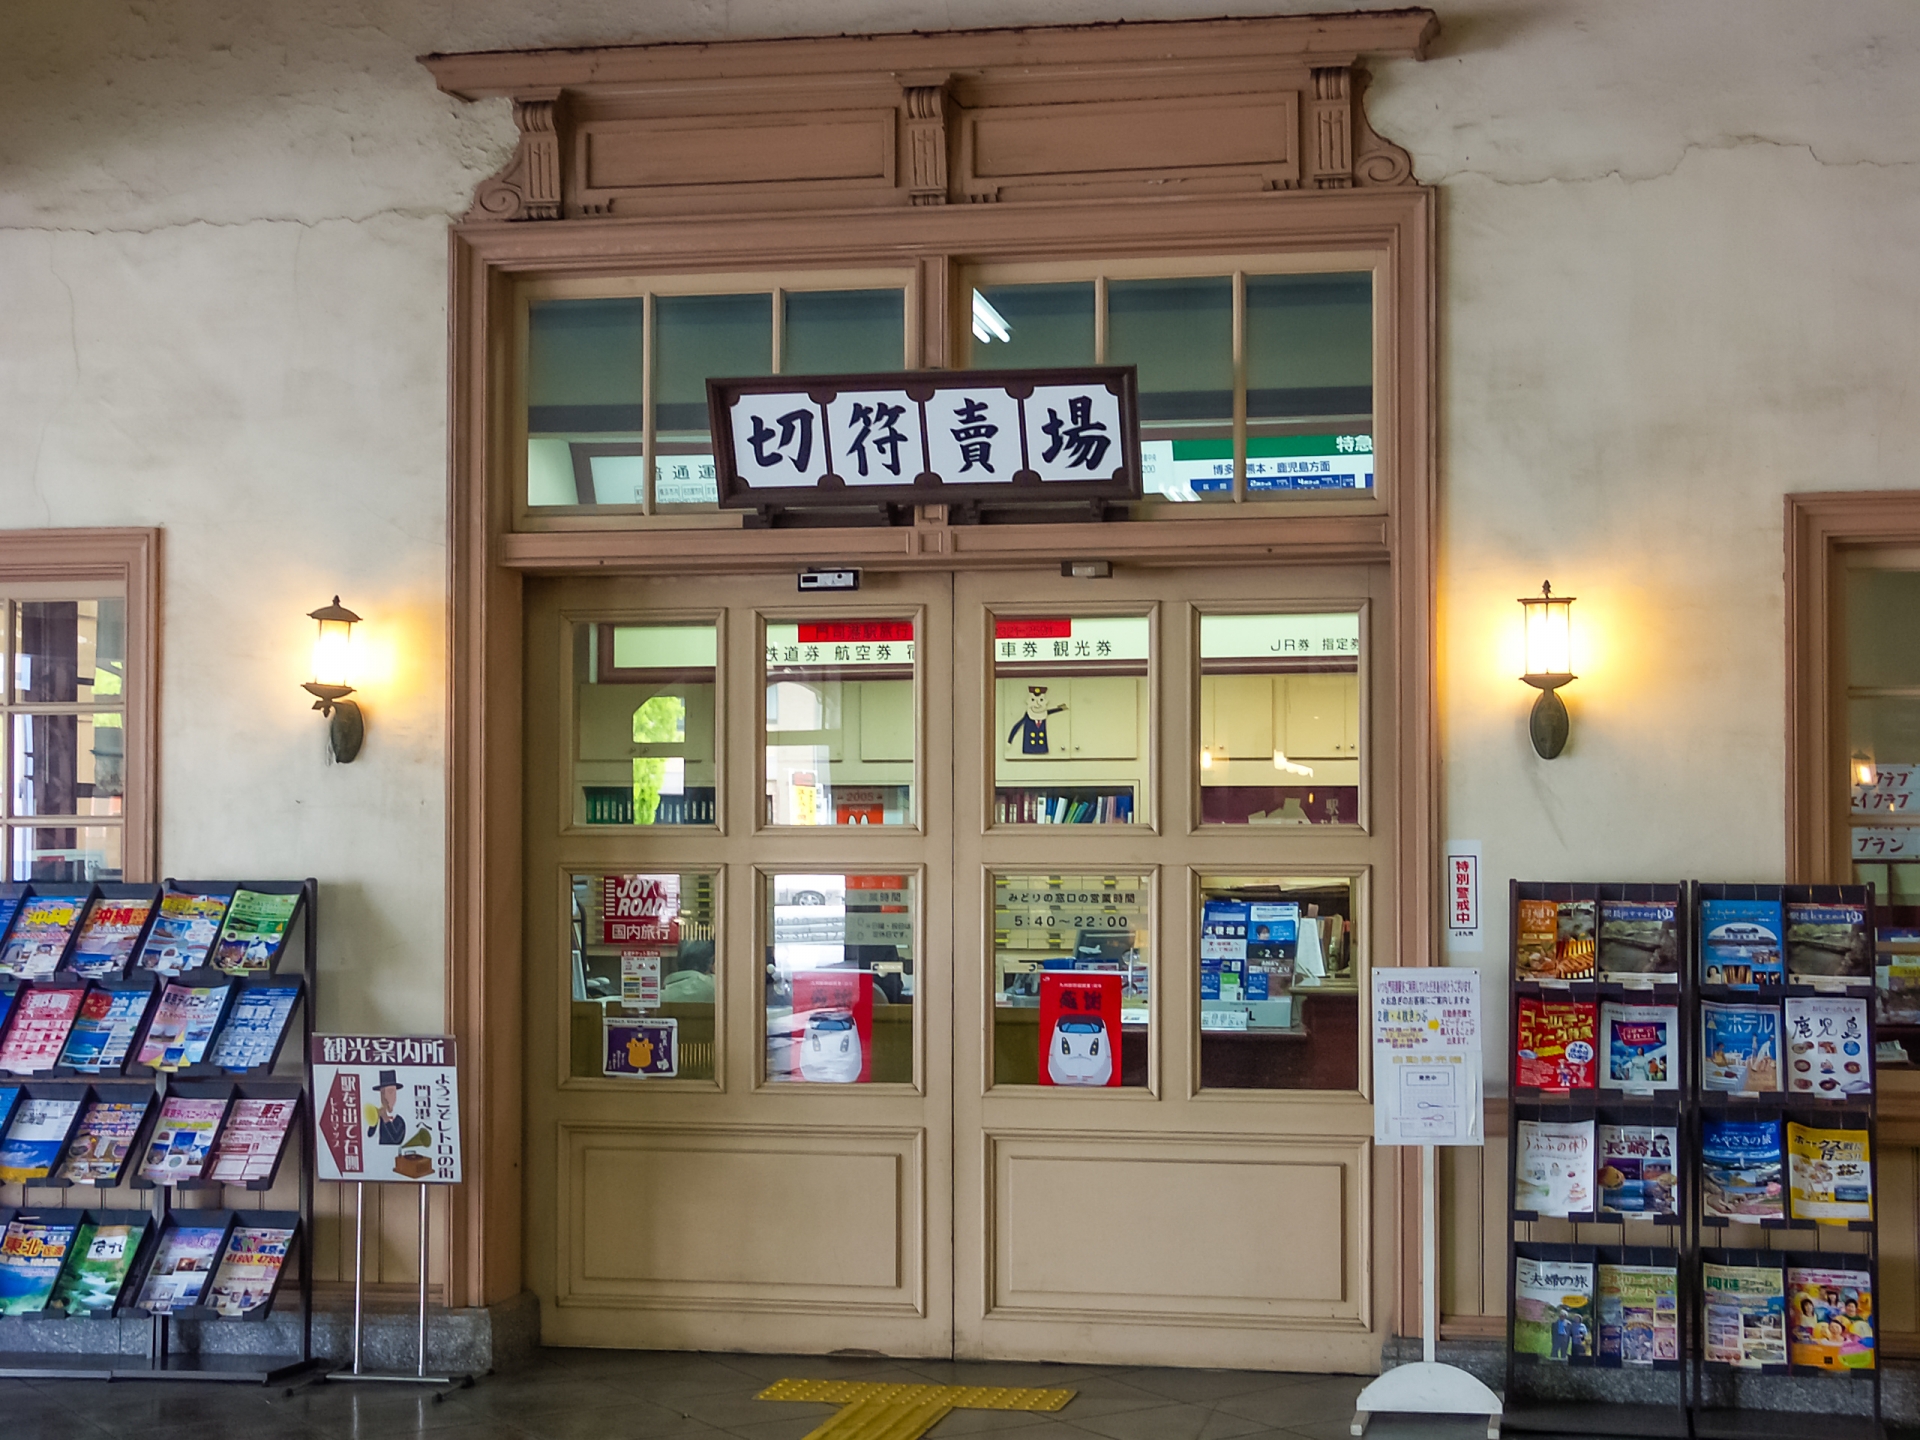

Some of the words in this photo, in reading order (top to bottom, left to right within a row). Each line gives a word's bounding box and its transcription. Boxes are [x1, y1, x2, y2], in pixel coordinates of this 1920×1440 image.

[747, 396, 1112, 477] 切符賣場
[834, 644, 892, 661] 航空券
[1053, 640, 1112, 657] 観光券
[616, 880, 655, 898] JOY
[1008, 892, 1135, 904] みどりの窓口の営業時間
[1455, 860, 1471, 925] 特別警戒中
[616, 897, 668, 917] ROAD
[612, 924, 670, 940] 国内旅行
[1728, 1014, 1774, 1034] ホテル
[1792, 1015, 1862, 1040] 鹿児島
[323, 1037, 445, 1064] 観光案内所
[340, 1075, 360, 1171] 駅を出て右側
[1710, 1133, 1773, 1148] みやざきの旅
[4, 1235, 43, 1256] 東北
[1519, 1270, 1589, 1289] ご夫婦の旅
